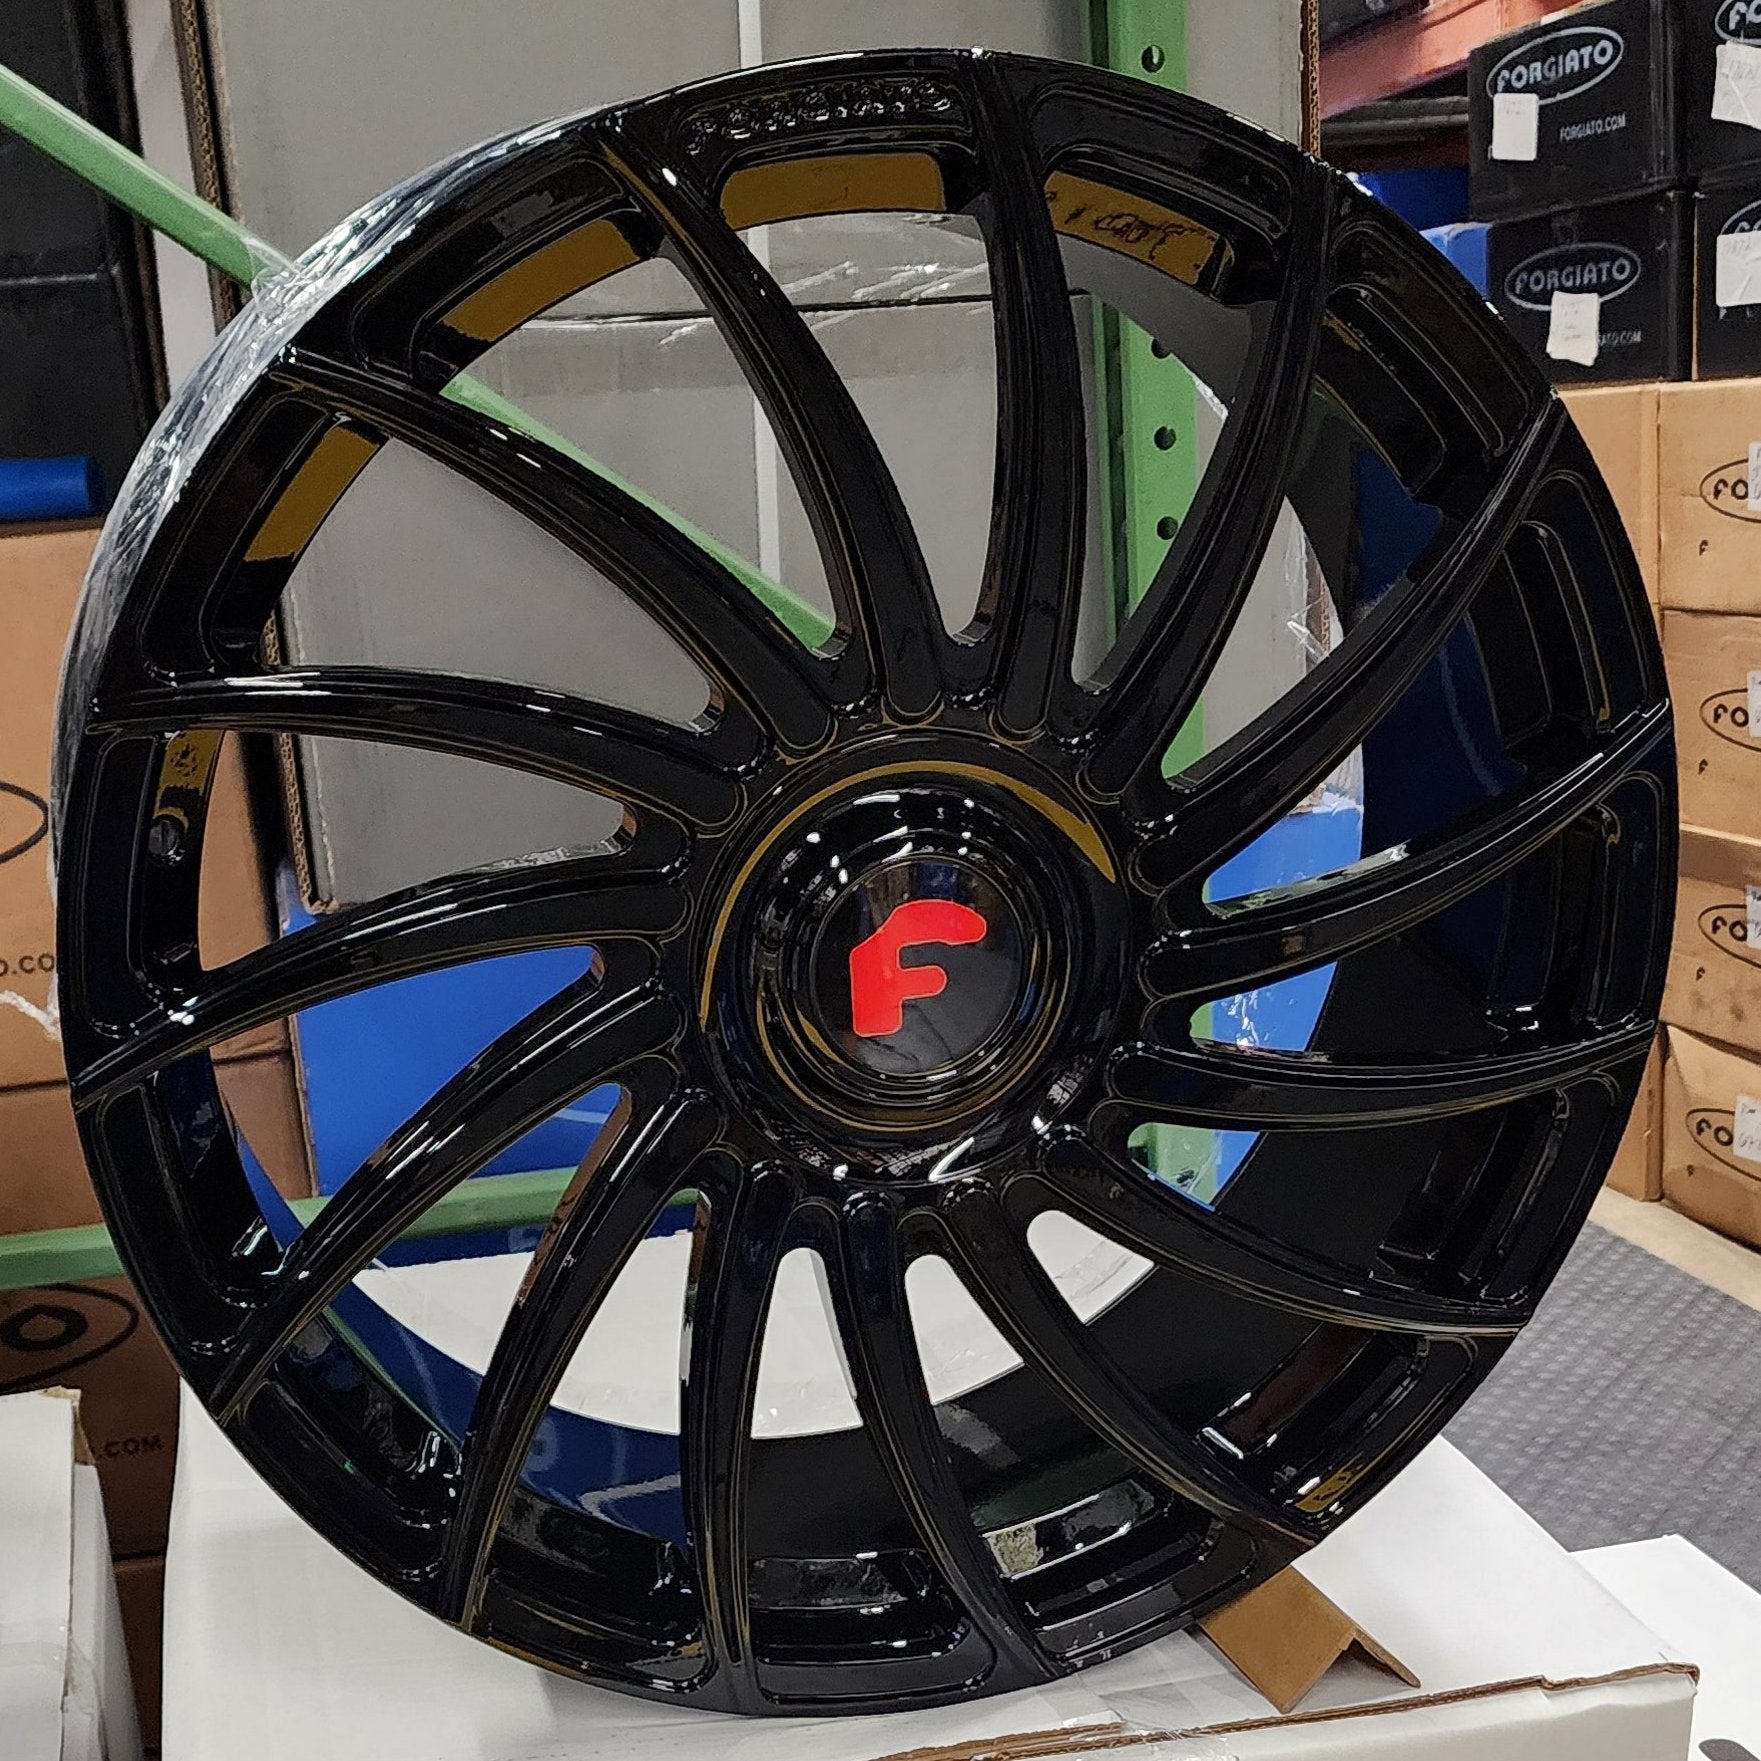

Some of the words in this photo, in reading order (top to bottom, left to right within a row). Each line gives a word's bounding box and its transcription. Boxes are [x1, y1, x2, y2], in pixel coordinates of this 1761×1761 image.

[1496, 38, 1614, 93] FORGIATO
[1559, 111, 1626, 141] FORGIATO.COM
[1514, 257, 1631, 295] FORGIATO
[849, 898, 987, 1038] F
